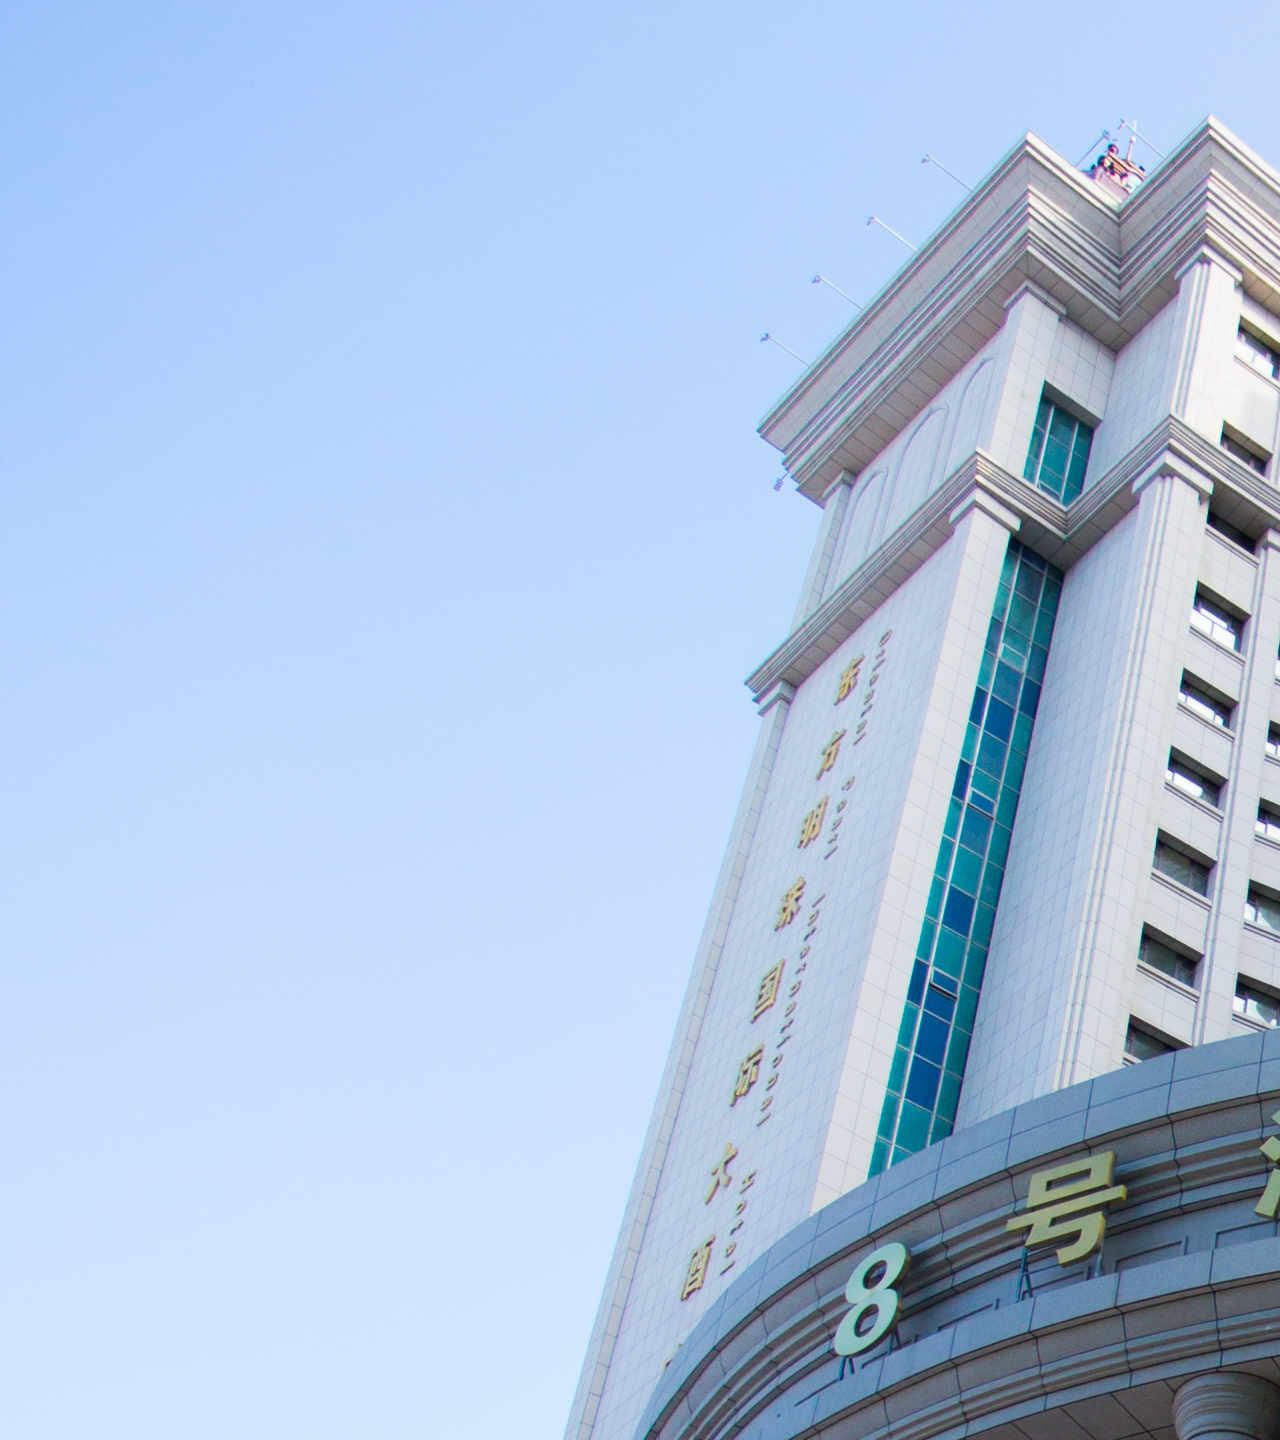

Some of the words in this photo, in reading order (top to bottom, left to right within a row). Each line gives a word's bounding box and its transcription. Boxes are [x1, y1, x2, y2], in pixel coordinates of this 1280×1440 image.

[663, 654, 866, 1369] 东方明珠国际大酒
